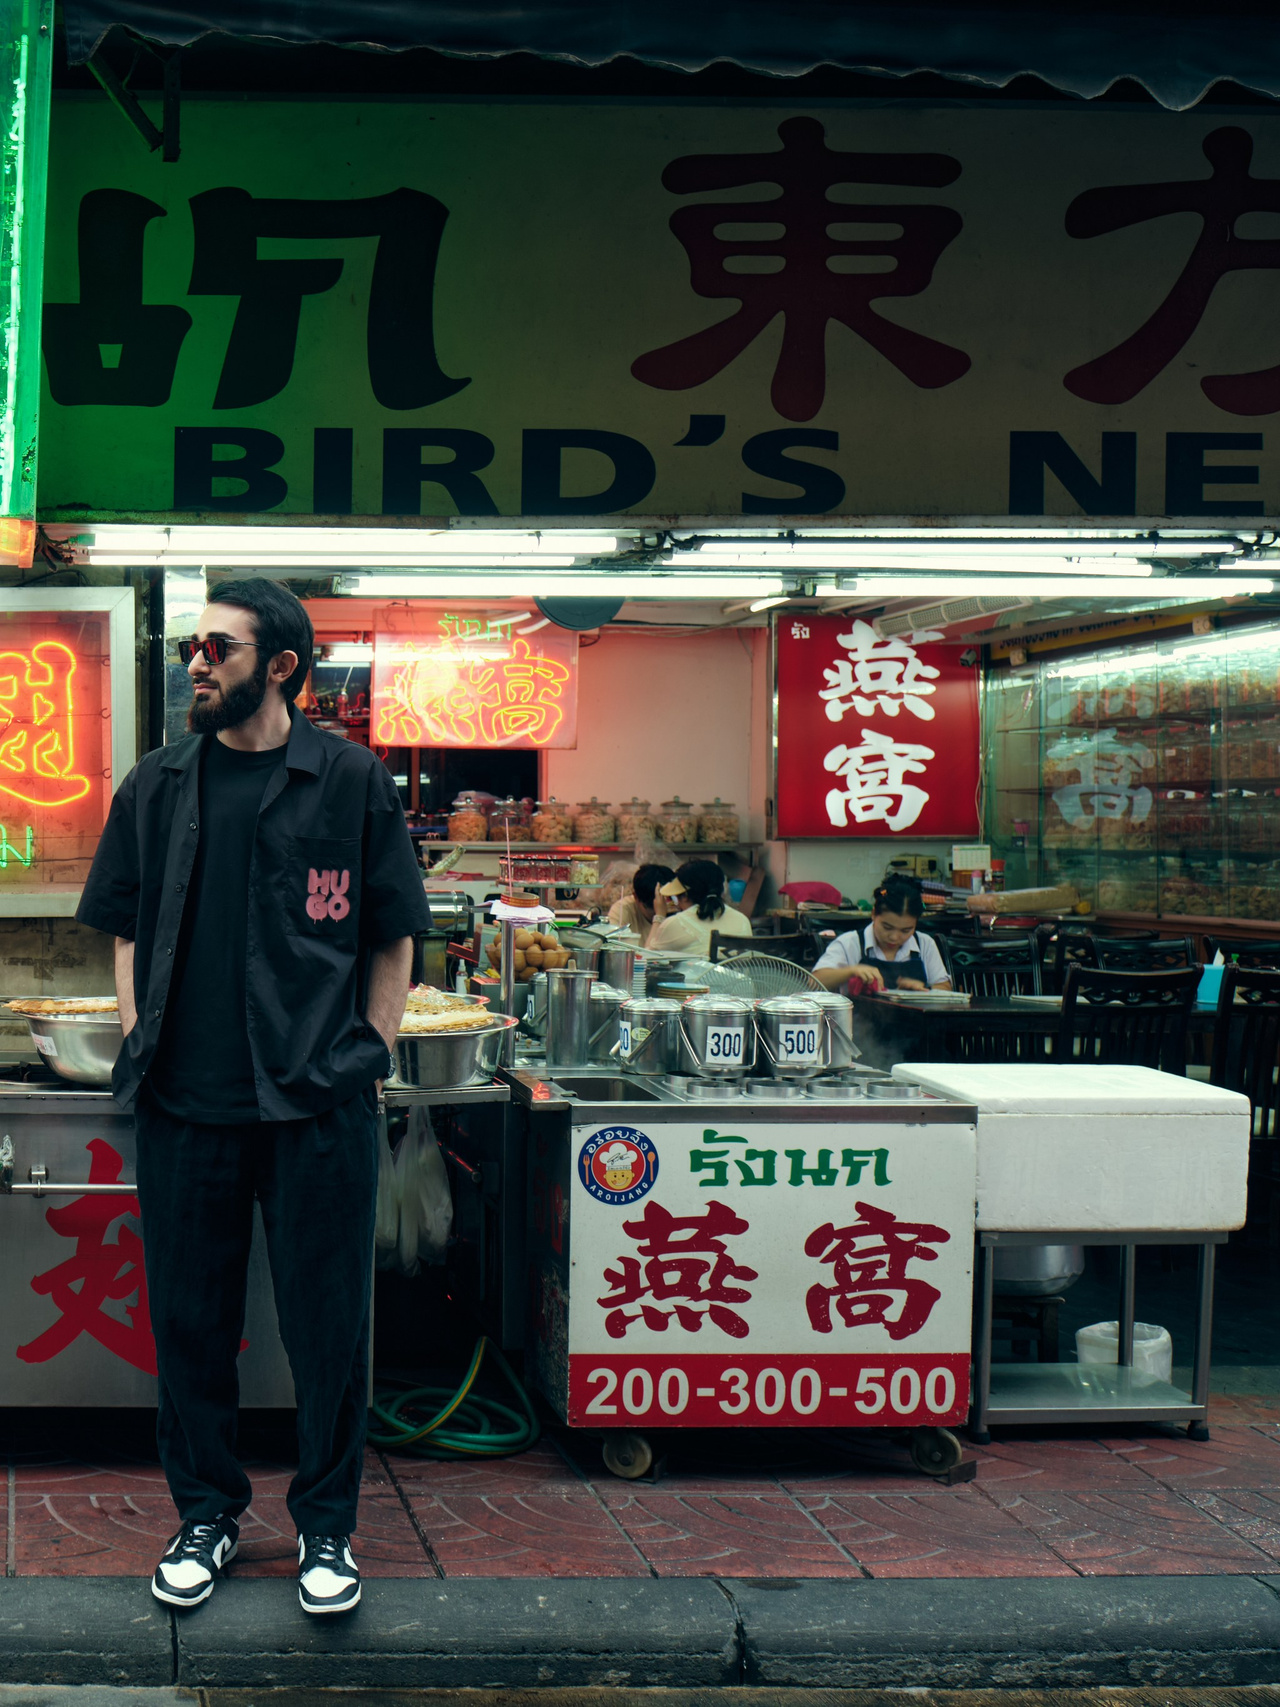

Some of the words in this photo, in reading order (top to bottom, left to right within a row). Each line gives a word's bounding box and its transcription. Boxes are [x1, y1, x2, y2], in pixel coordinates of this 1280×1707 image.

[173, 414, 846, 516] BIRD'S
[818, 618, 946, 832] 燕窩
[710, 1032, 741, 1058] 300
[785, 1029, 815, 1055] 500
[689, 1129, 893, 1187] รังนก
[589, 1182, 649, 1203] AROIJANG
[597, 1200, 951, 1341] 燕窩
[585, 1366, 957, 1417] 200-300-500
